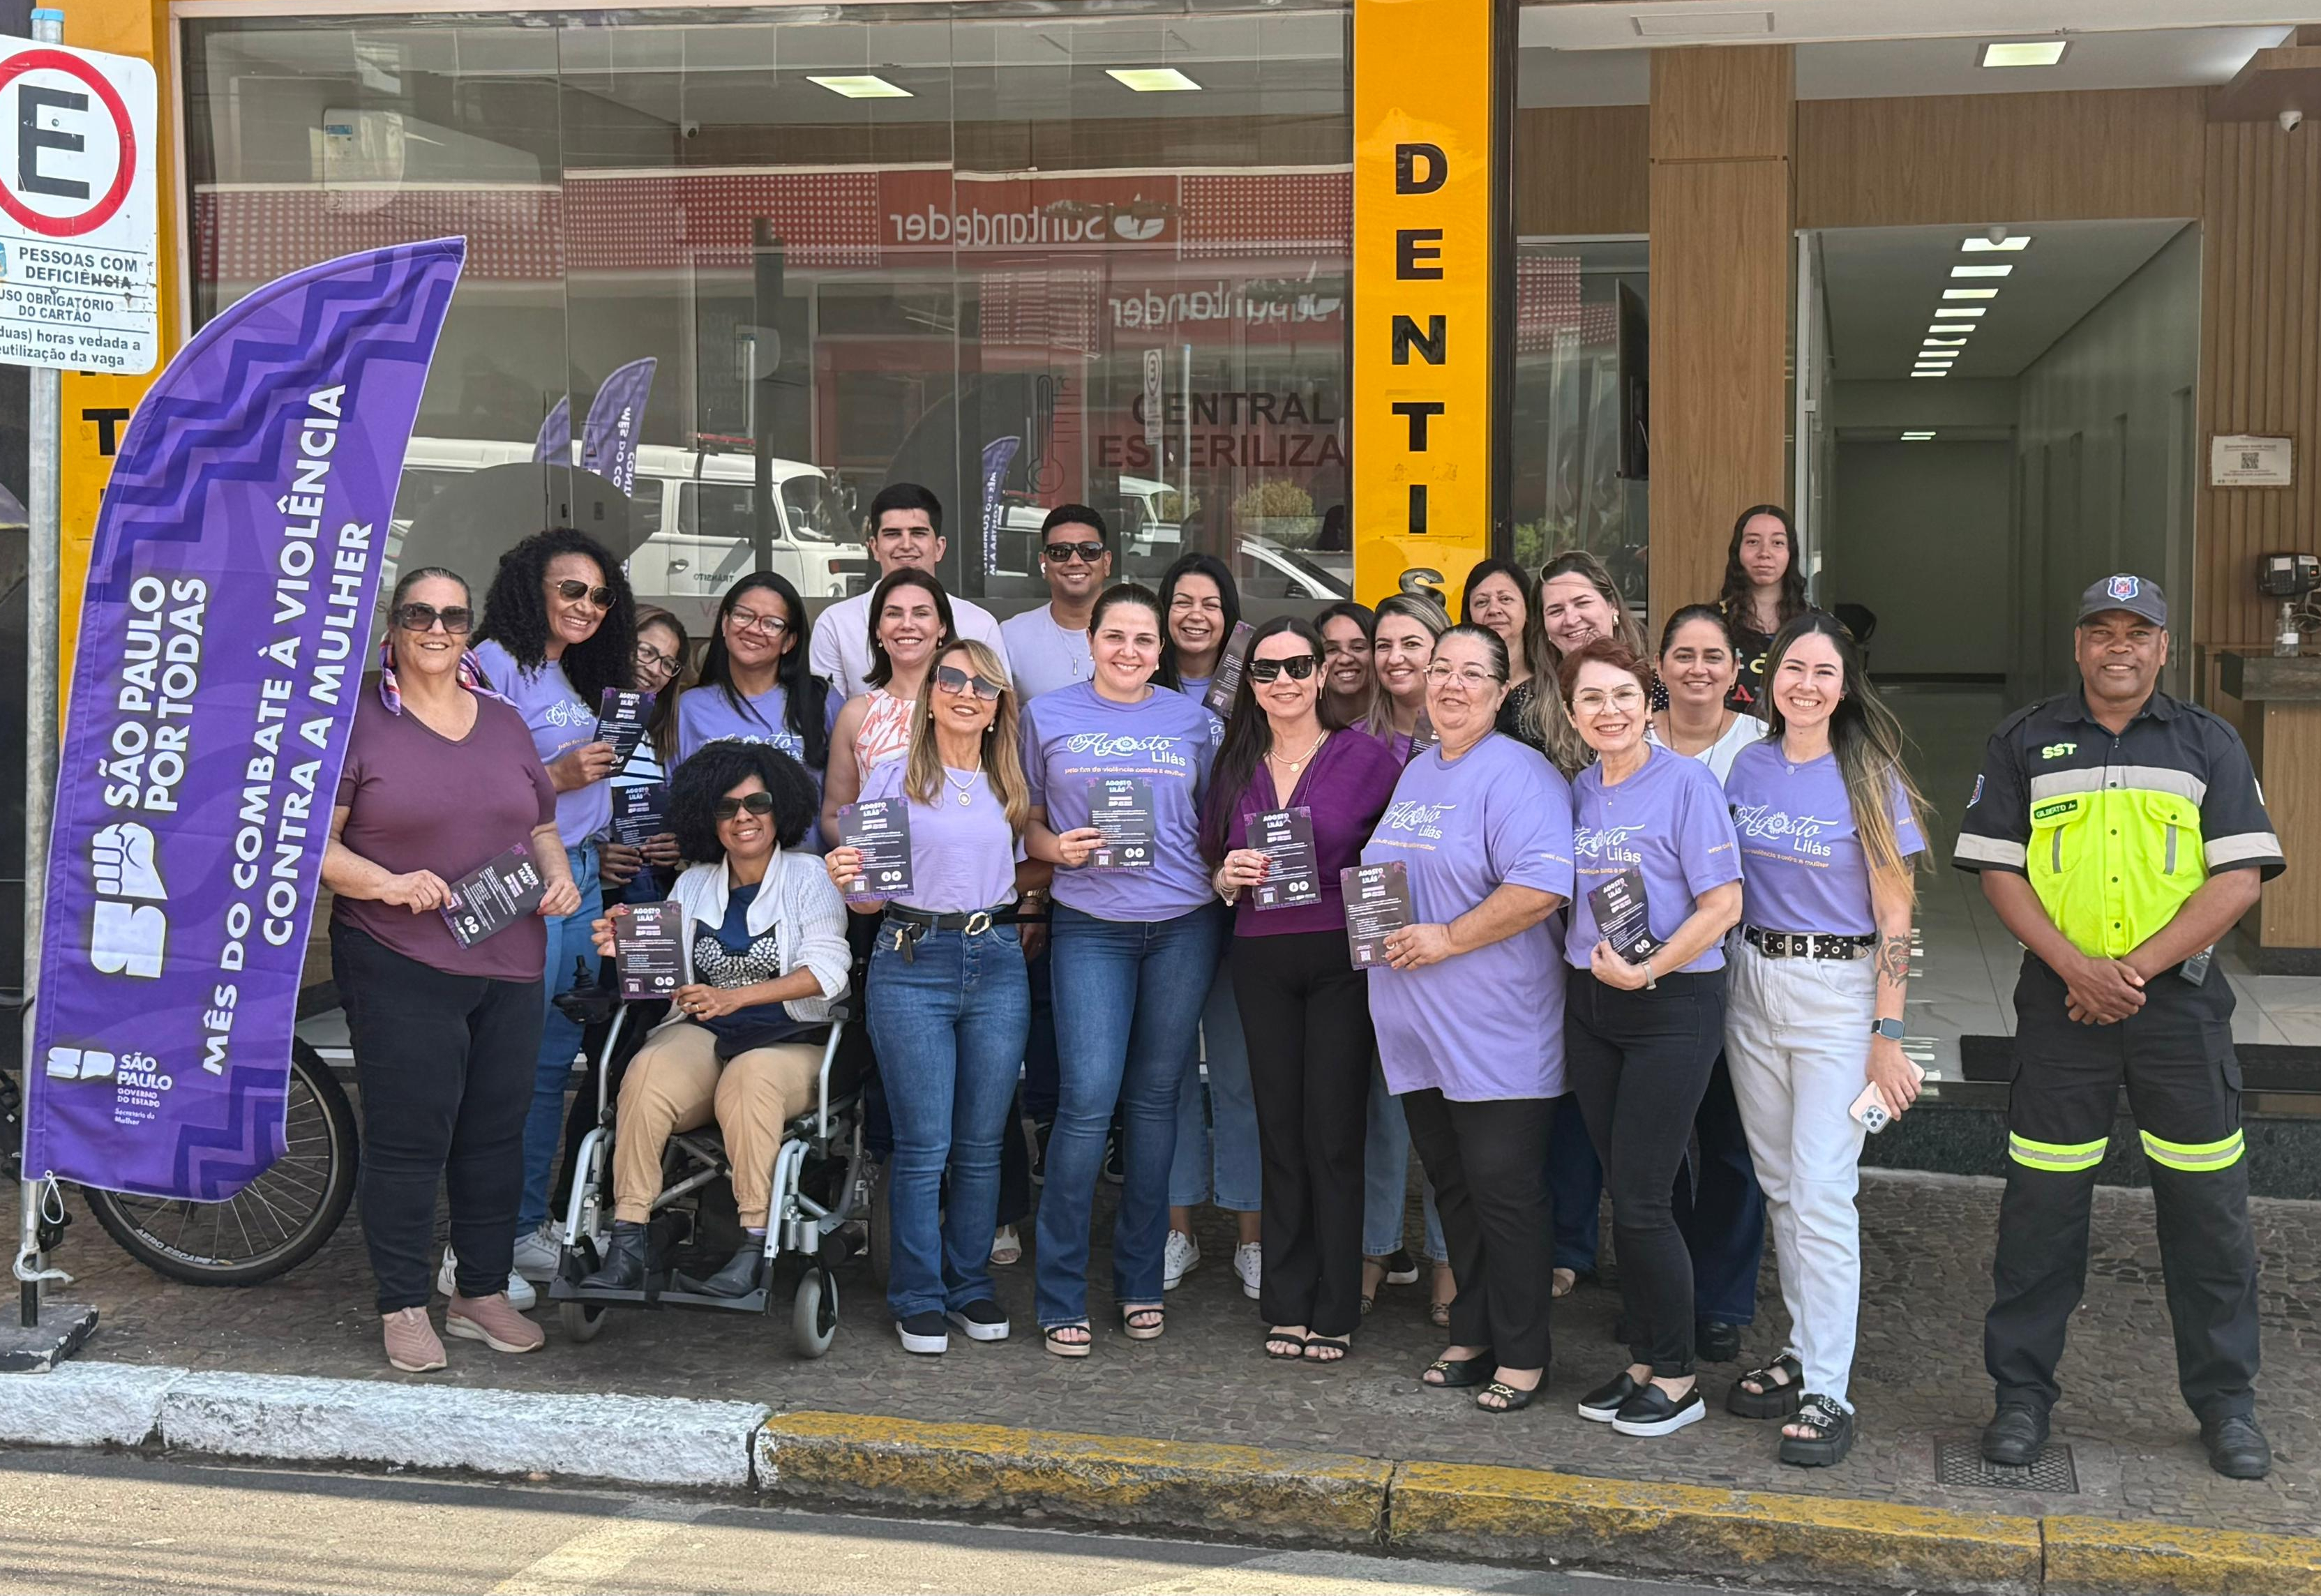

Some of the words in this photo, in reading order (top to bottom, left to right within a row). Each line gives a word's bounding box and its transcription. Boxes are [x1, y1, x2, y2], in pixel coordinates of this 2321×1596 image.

[18, 84, 90, 200] E
[20, 246, 95, 269] PESSOAS
[100, 256, 137, 273] COM
[26, 265, 132, 289] DEFICIÊNCIA
[19, 305, 36, 317] DO
[40, 308, 91, 322] CARTÃO
[27, 292, 114, 311] OBRIGATÓRIO
[37, 329, 74, 345] horas
[79, 332, 128, 349] vedada
[133, 341, 141, 351] a
[70, 349, 87, 362] da
[91, 354, 125, 368] vaga
[1132, 392, 1335, 426] CENTRAL
[273, 384, 347, 624] VIOLÊNCIA
[308, 522, 373, 707] MULHER
[119, 576, 165, 712] PAULO
[157, 578, 207, 719] TODAS
[257, 635, 301, 670] À
[299, 716, 334, 751] A
[1067, 732, 1182, 757] Agosto
[1152, 751, 1186, 767] Lilás
[2042, 743, 2078, 759] SST
[98, 721, 149, 809] SÃO
[144, 725, 190, 812] POR
[233, 679, 293, 890] COMBATE
[1418, 825, 1443, 839] Lilás
[262, 759, 323, 946] CONTRA
[1606, 847, 1642, 863] Lilás
[1794, 837, 1832, 857] Lilás
[220, 902, 251, 971] DO
[202, 983, 238, 1076] MÊS
[119, 1051, 157, 1072] SÃO
[117, 1070, 172, 1090] PAULO
[117, 1087, 158, 1099] GOVERNO
[117, 1095, 130, 1104] DO
